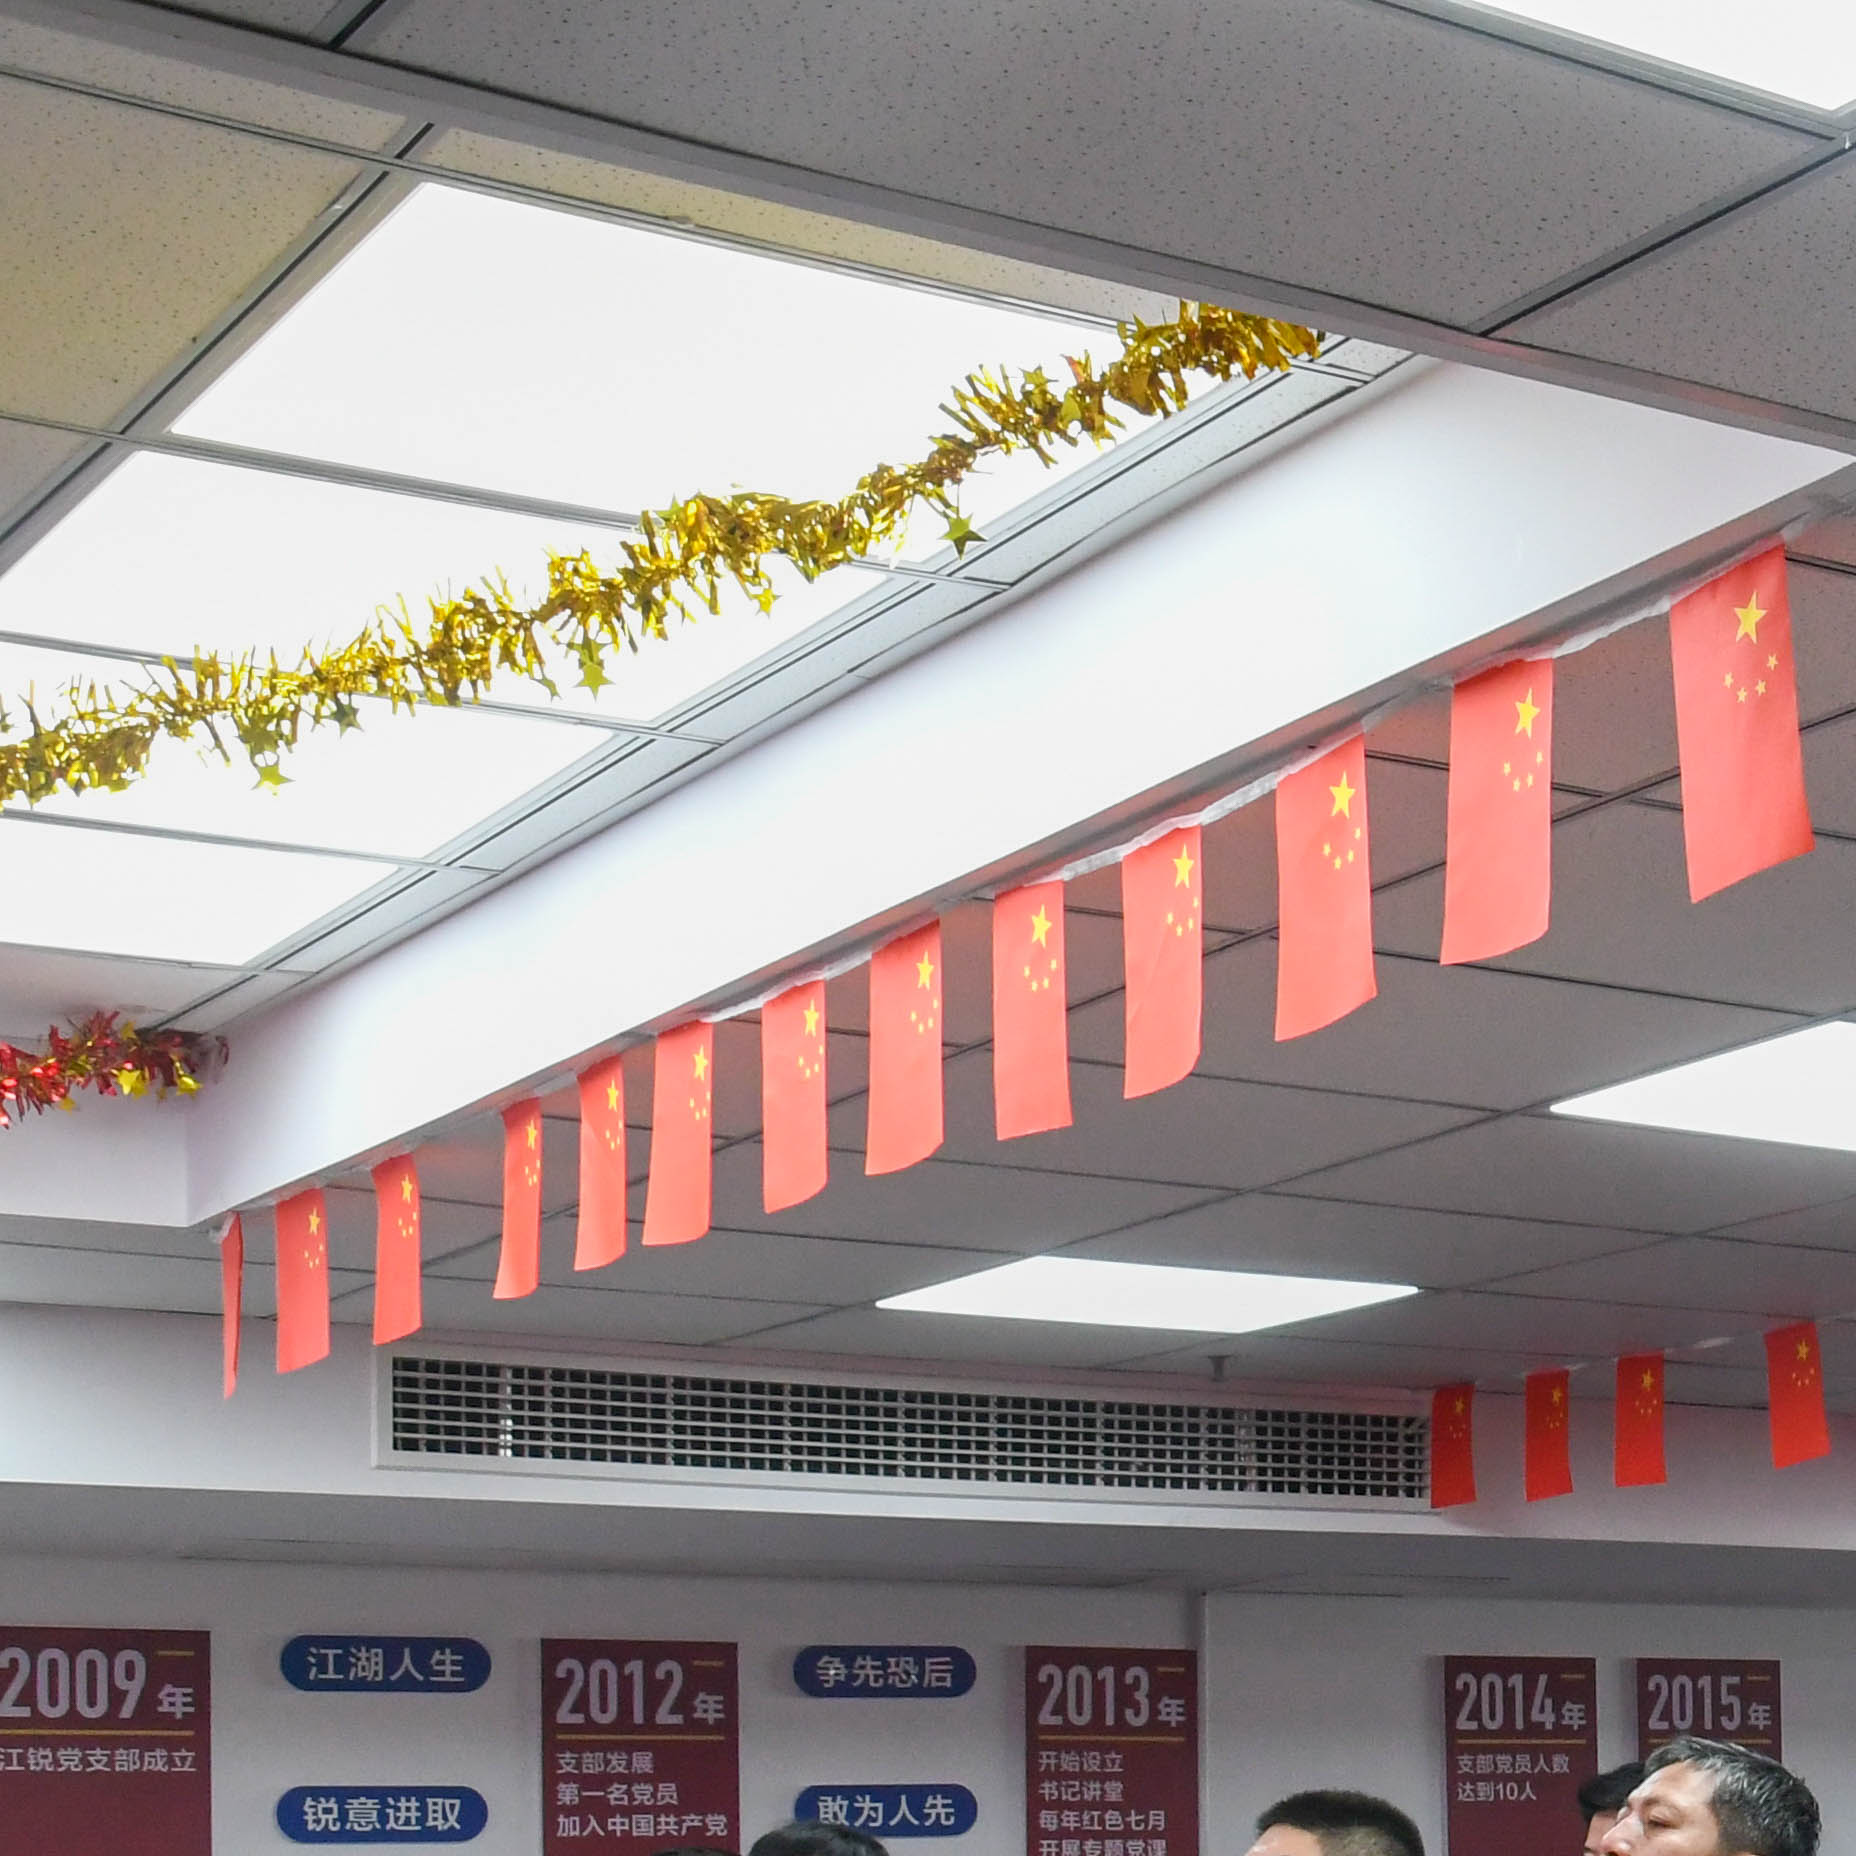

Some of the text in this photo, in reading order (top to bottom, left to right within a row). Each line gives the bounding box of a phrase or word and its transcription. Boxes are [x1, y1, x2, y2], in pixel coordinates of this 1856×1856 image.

[306, 1646, 465, 1682] 江湖人生
[816, 1655, 953, 1688] 争先恐后
[555, 1658, 726, 1725] 2012年
[1038, 1664, 1187, 1727] 2013年
[1455, 1672, 1587, 1731] 2014年
[1648, 1674, 1771, 1731] 2015年
[556, 1751, 654, 1775] 支部发展
[1038, 1751, 1125, 1773] 开始设立
[1456, 1753, 1570, 1774] 支部党员人数
[556, 1782, 679, 1806] 第一名党员
[1038, 1780, 1125, 1802] 书记讲堂
[1456, 1781, 1537, 1802] 达到10人
[303, 1796, 462, 1832] 锐意进取
[817, 1794, 955, 1827] 敢为人先
[1039, 1809, 1166, 1832] 每年红色七月
[556, 1813, 728, 1837] 加入中国共产党
